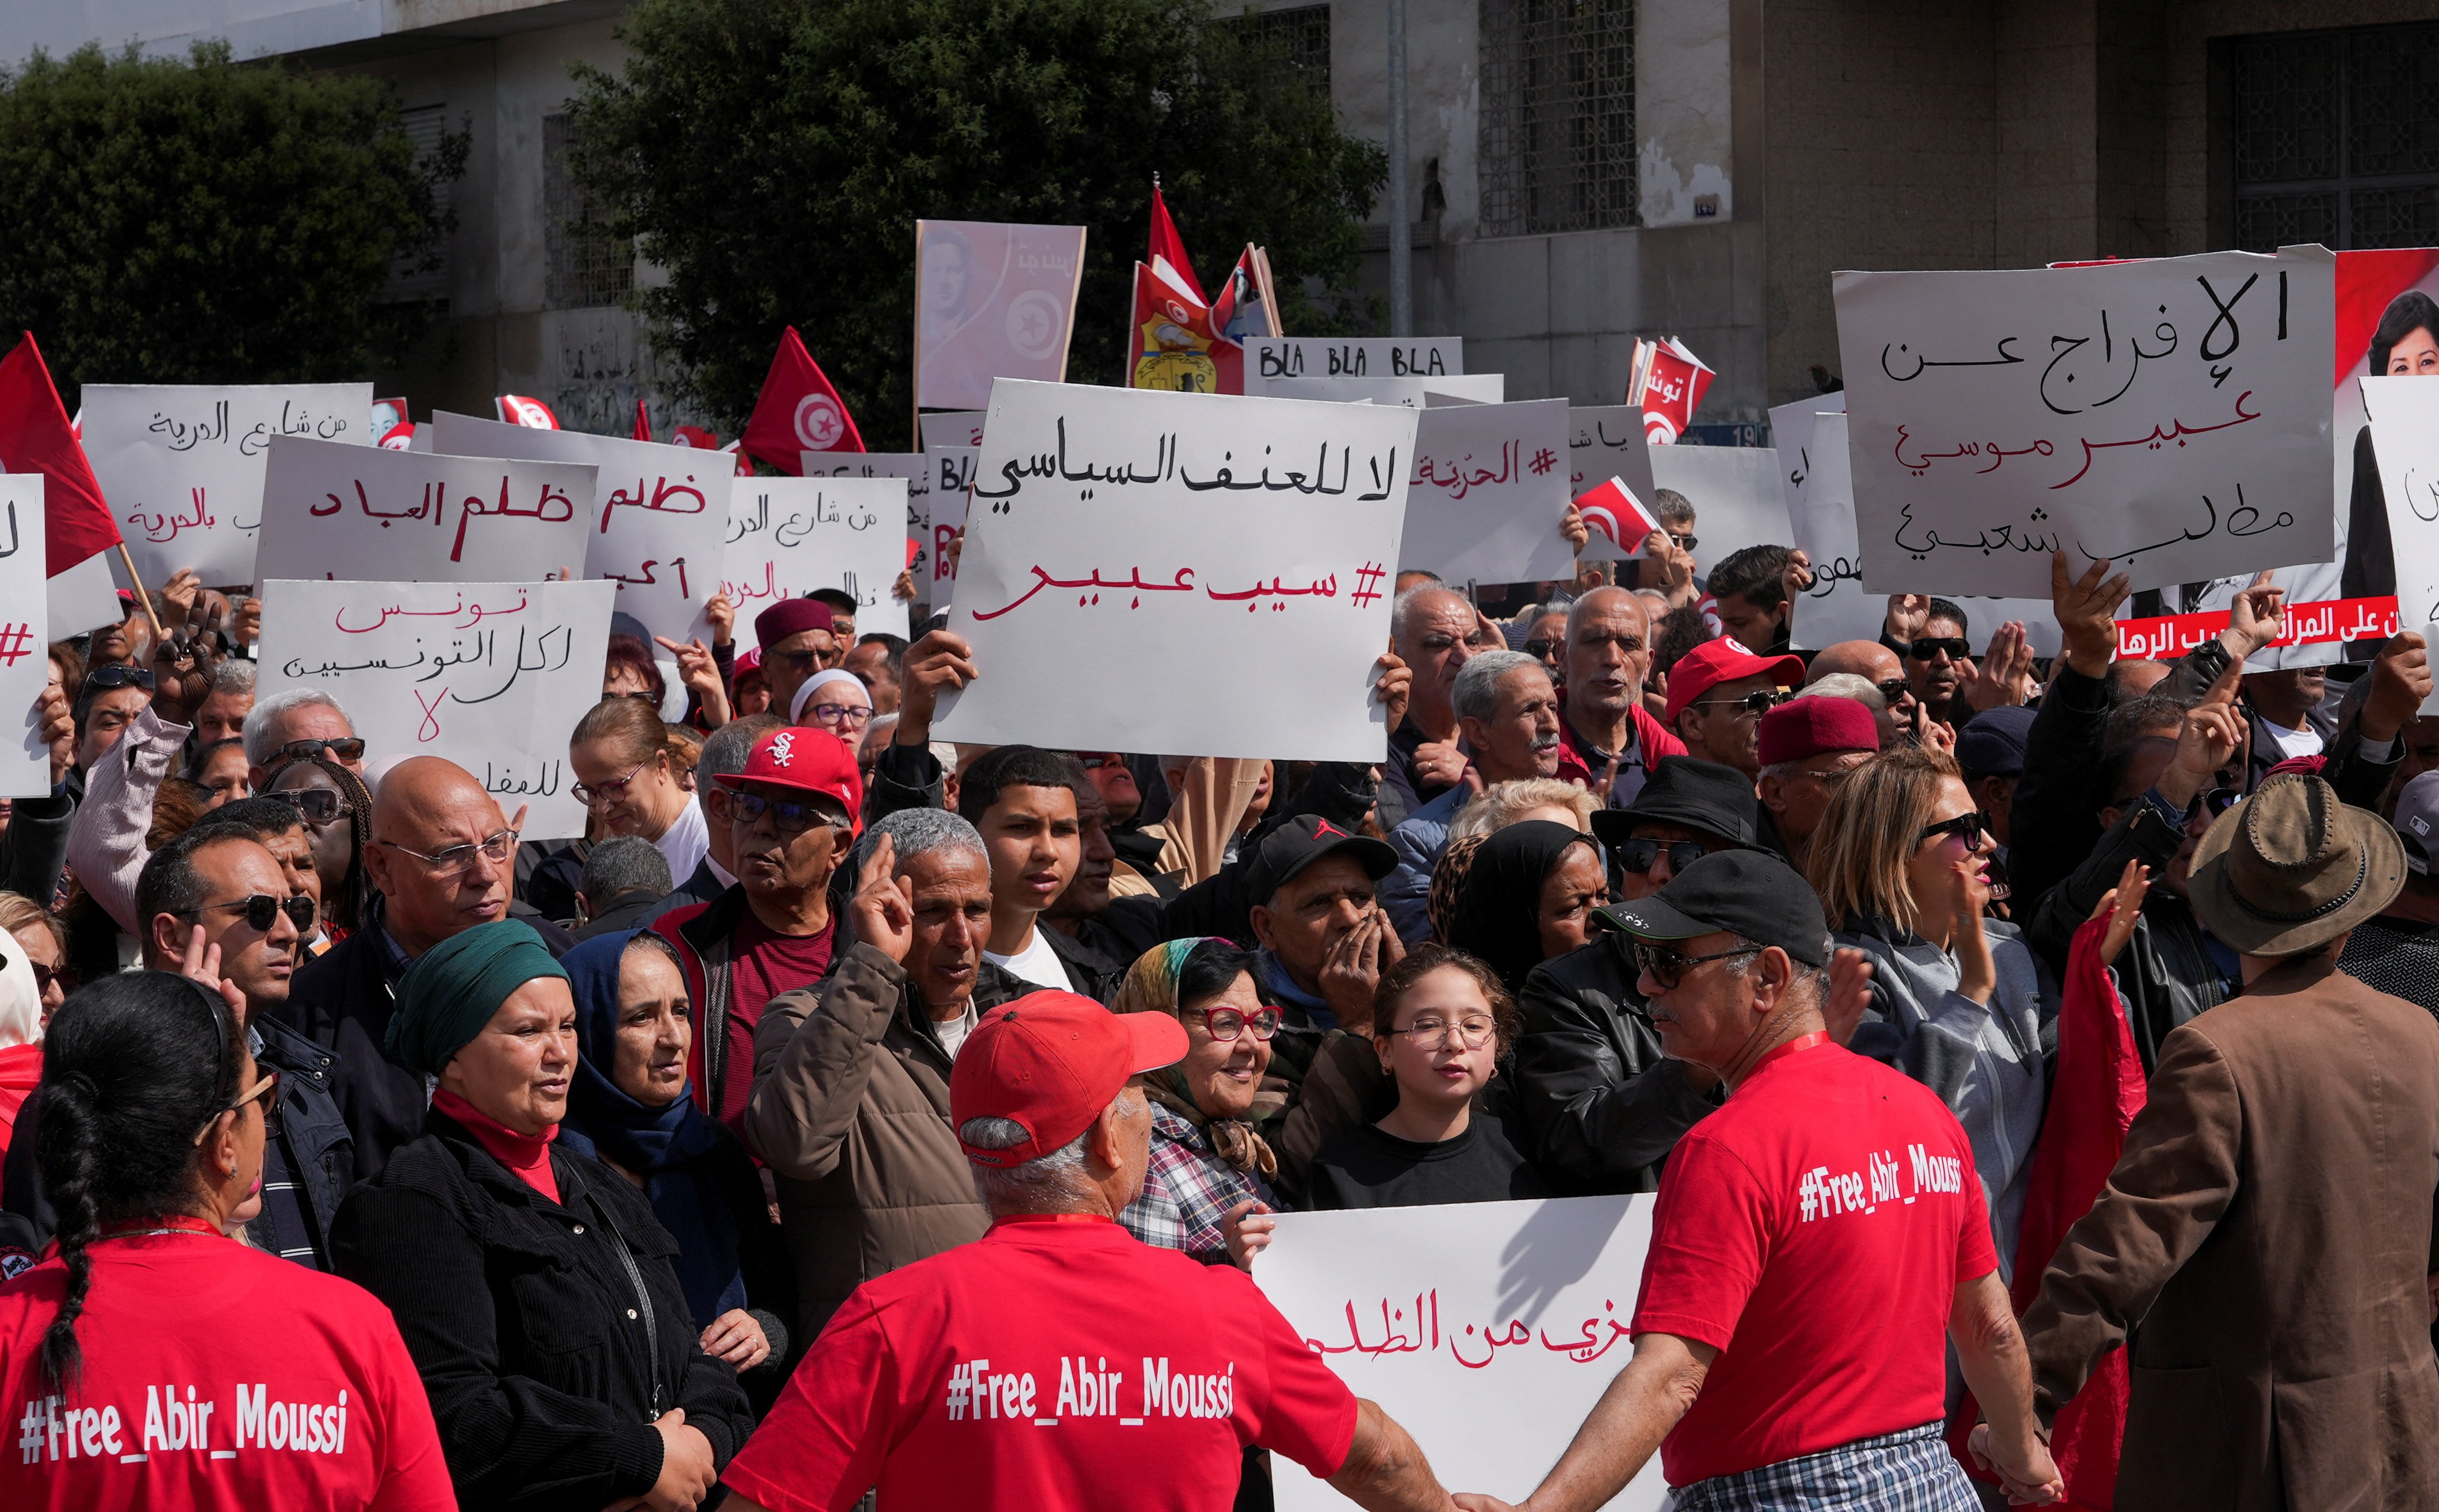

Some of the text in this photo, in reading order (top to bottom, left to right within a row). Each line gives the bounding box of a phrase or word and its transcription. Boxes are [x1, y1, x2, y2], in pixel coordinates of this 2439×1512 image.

[1260, 343, 1445, 377] BLA BLA BLA
[1882, 271, 2288, 414] الإفراج عن
[148, 400, 346, 456] من شارع الحرية
[2048, 390, 2261, 489] عبير
[941, 456, 978, 492] BL
[973, 415, 1176, 515] السياسي
[1180, 440, 1351, 496] للعنف
[1357, 445, 1396, 501] لا
[309, 475, 574, 562] ظلم العباد
[601, 475, 706, 534] ظلم
[725, 494, 769, 543] الحر
[775, 492, 840, 547] شارع
[848, 505, 877, 531] من
[2077, 483, 2293, 564] مطلب
[335, 588, 527, 633] تونس
[720, 560, 788, 609] بالحري
[972, 564, 1195, 621] عبير
[1206, 572, 1337, 613] سيب
[2339, 604, 2379, 642] على
[412, 686, 450, 742] لا
[1450, 1319, 1530, 1369] من
[1540, 1299, 1631, 1363] زي
[946, 1356, 1234, 1426] #Free_Abir_Moussi
[20, 1383, 347, 1465] #Free_Abir_Moussi
